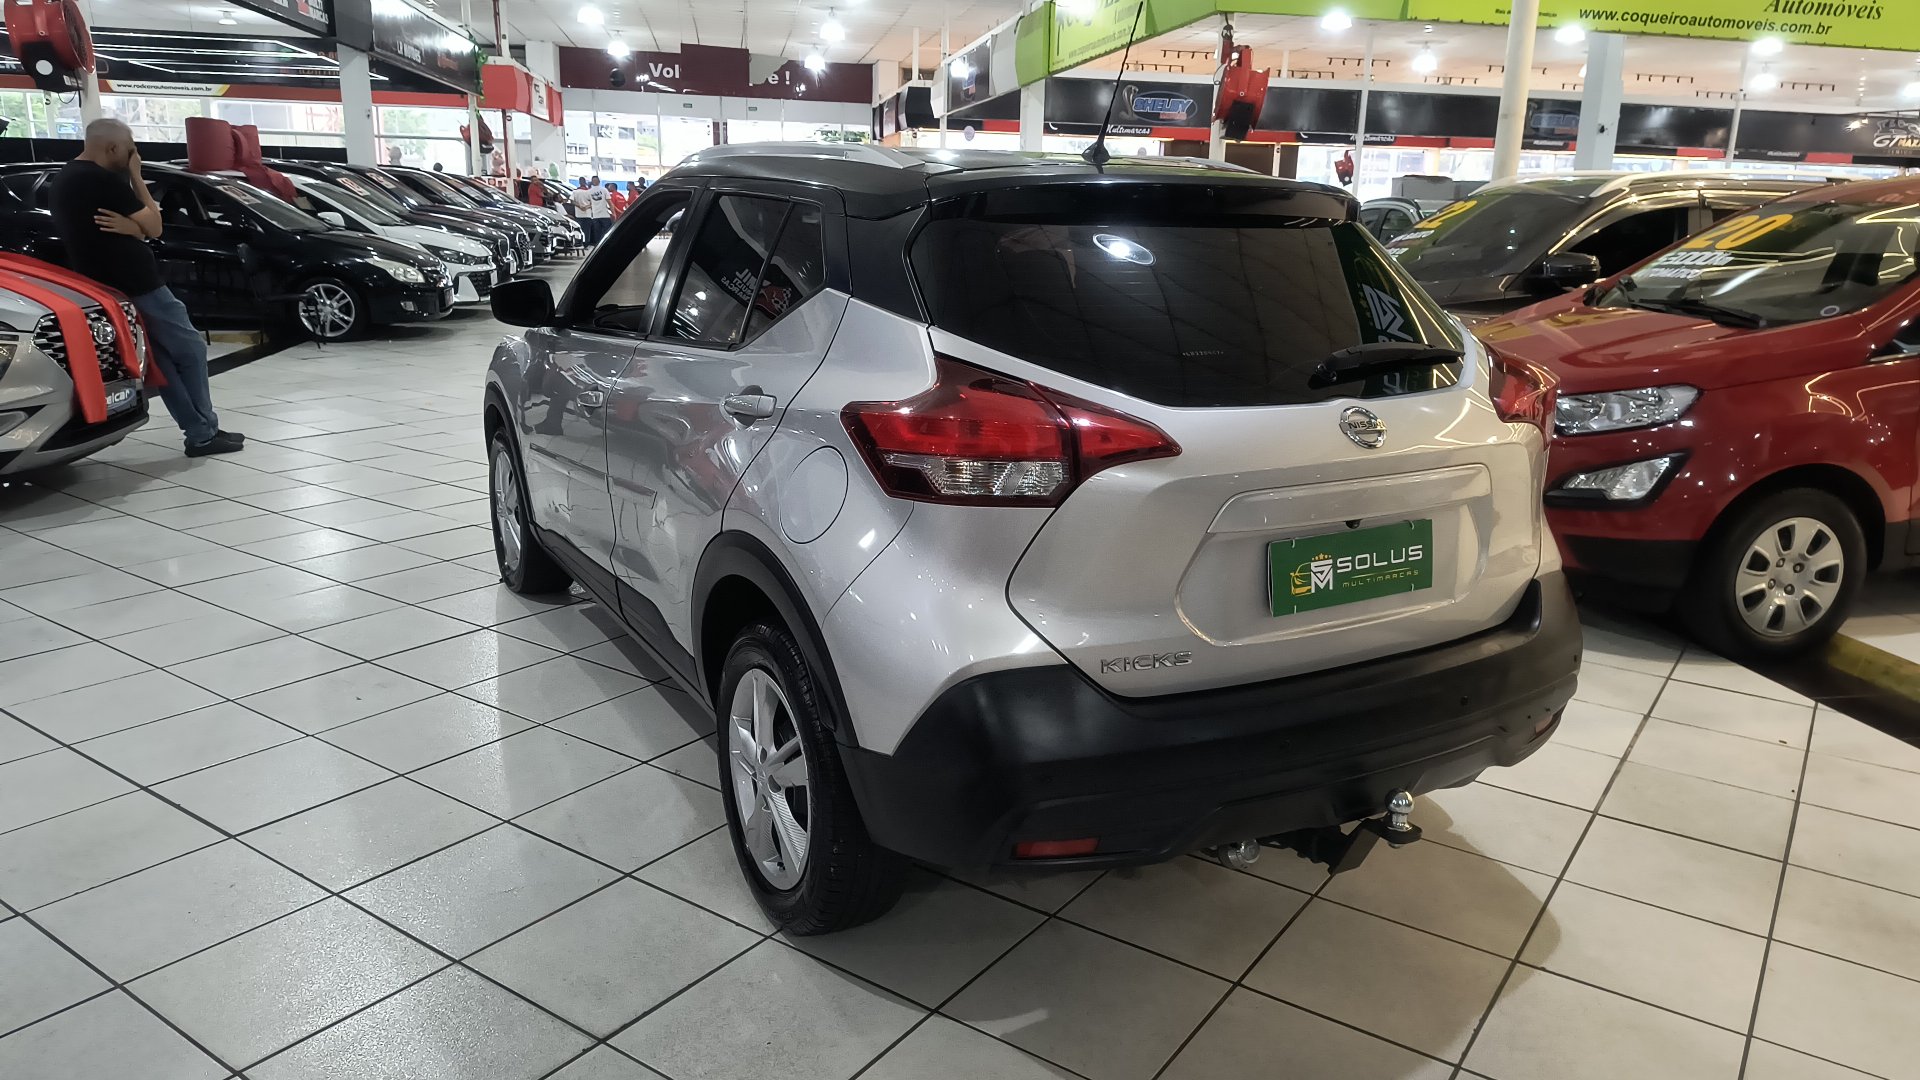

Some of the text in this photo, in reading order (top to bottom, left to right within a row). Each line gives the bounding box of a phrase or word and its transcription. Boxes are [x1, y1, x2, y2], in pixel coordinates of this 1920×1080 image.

[1579, 8, 1832, 35] www.coqueiroautomoveis.com.br
[1133, 97, 1193, 113] SHELBY
[1680, 213, 1793, 250] 20
[1336, 544, 1423, 573] SOLUS
[1342, 569, 1419, 588] MULTIMARCAS
[1101, 651, 1193, 674] KICKS
